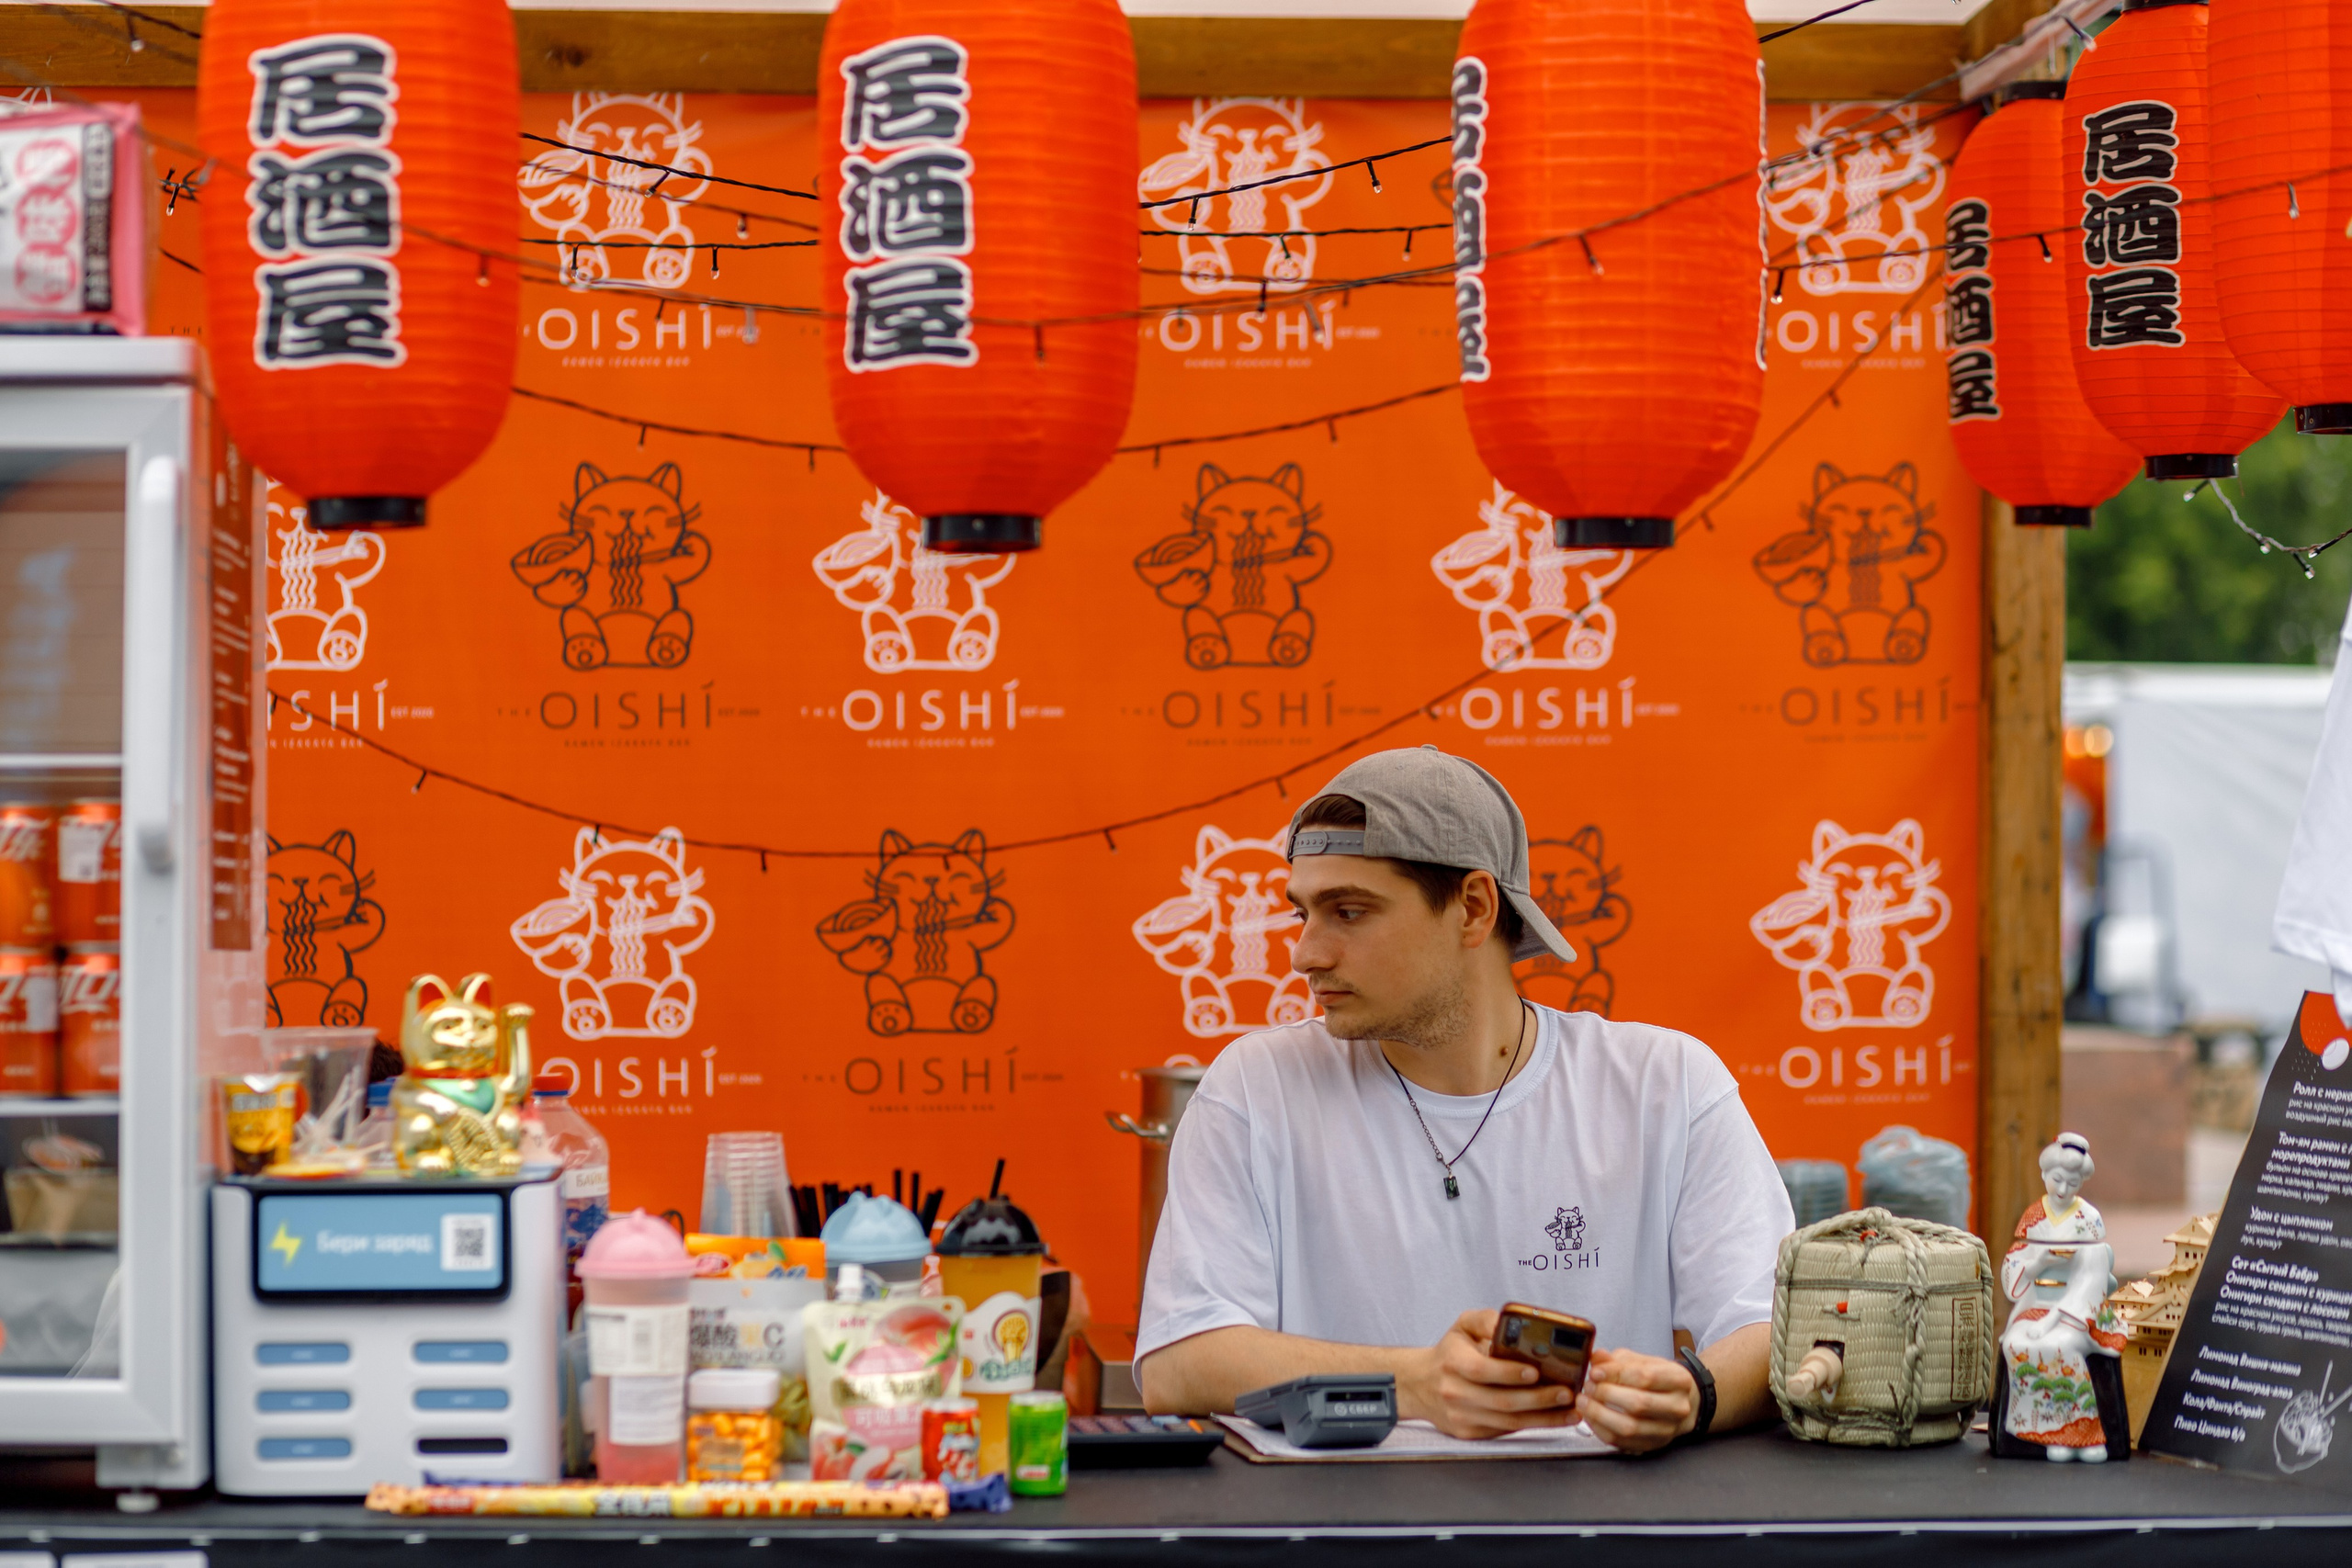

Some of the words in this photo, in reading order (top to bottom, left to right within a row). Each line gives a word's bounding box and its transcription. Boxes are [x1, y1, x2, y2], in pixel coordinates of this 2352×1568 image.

[246, 33, 406, 371] 居酒屋
[840, 34, 978, 373] 居酒屋
[2081, 99, 2186, 350] 居酒屋
[267, 678, 389, 731] ISHÍ
[540, 680, 714, 730] OISHÍ
[842, 678, 1020, 731] OISHÍ
[1162, 680, 1336, 729] OISHÍ
[1460, 675, 1636, 730] OISHÍ
[1780, 675, 1951, 727] OISHÍ
[844, 1045, 1019, 1096] OISHÍ
[1779, 1033, 1955, 1089] OISHÍ
[2293, 1080, 2316, 1096] Ролл
[2317, 1088, 2324, 1098] с
[2285, 1110, 2327, 1123] воздушный
[2288, 1099, 2302, 1109] рис
[2303, 1100, 2312, 1111] на
[2313, 1101, 2345, 1114] красном
[2278, 1131, 2311, 1148] Том-ям
[2271, 1148, 2351, 1170] морепродуктами
[2302, 1190, 2330, 1205] кунжут
[2245, 1223, 2276, 1236] куриное
[2250, 1205, 2273, 1223] Удон
[2274, 1212, 2280, 1224] с
[2280, 1213, 2334, 1232] цыпленком
[317, 1229, 369, 1255] Бери
[373, 1233, 434, 1255] заряд
[2256, 1238, 2283, 1251] кунжут
[1532, 1247, 1600, 1271] OISHÍ
[2232, 1255, 2249, 1270] Сет
[2250, 1258, 2289, 1279] «Сытый
[2225, 1269, 2268, 1291] Онигири
[2268, 1279, 2308, 1297] сендвич
[2308, 1286, 2316, 1299] с
[2220, 1284, 2263, 1306] Онигири
[2263, 1294, 2303, 1313] сендвич
[2302, 1302, 2311, 1314] с
[2310, 1303, 2350, 1321] лососем
[2199, 1345, 2239, 1367] Лимонад
[2239, 1352, 2301, 1377] Вишня-малина
[2190, 1369, 2231, 1390] Лимонад
[2182, 1391, 2267, 1420] Кола/Фанта/Спрайт
[2174, 1415, 2198, 1432] Пиво
